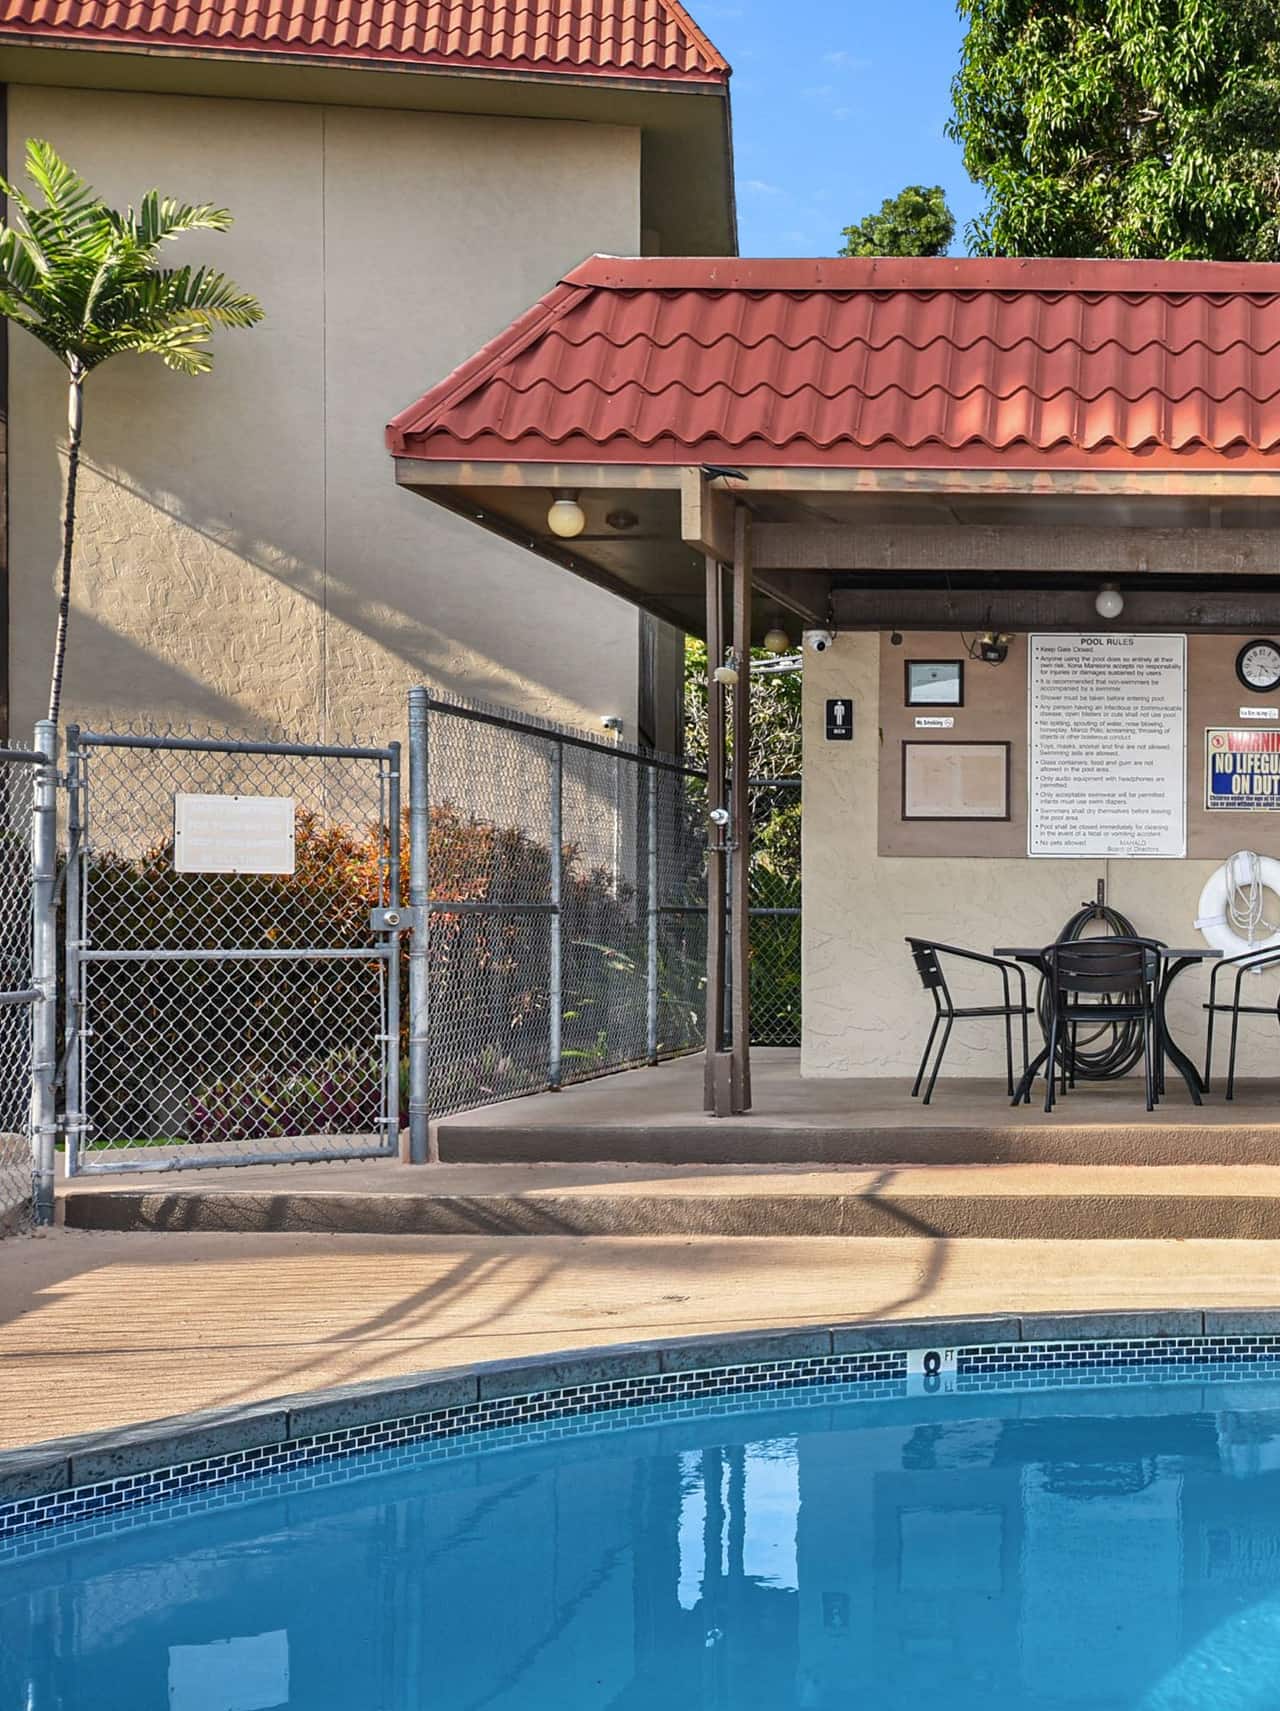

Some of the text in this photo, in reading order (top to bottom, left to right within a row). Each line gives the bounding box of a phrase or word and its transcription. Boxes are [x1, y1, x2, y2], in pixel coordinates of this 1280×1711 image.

[1216, 754, 1233, 774] NO
[1232, 775, 1250, 795] ON
[945, 1350, 954, 1360] FT
